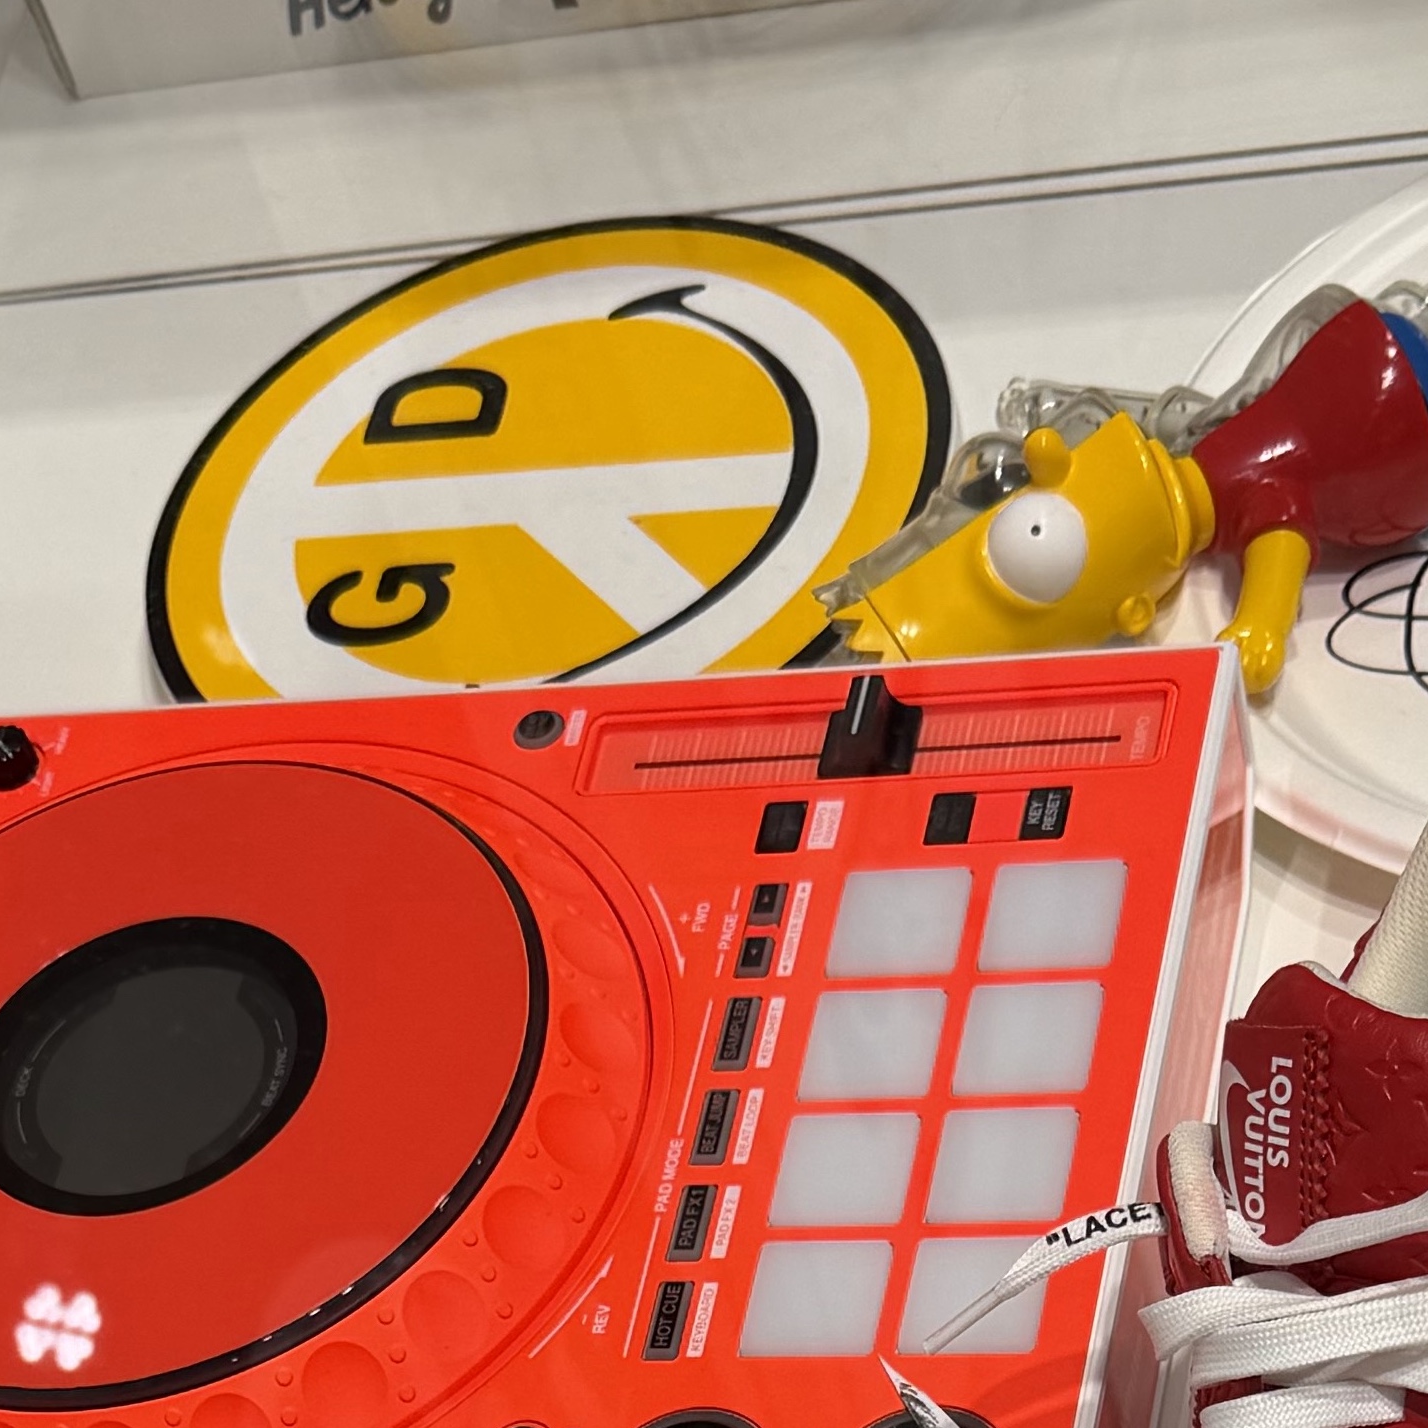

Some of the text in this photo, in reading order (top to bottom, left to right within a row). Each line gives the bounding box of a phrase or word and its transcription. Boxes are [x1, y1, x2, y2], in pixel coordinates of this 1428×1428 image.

[691, 902, 711, 933] FWD
[717, 913, 739, 950] PAGE
[1269, 1056, 1292, 1169] LOUIS
[653, 1138, 684, 1213] PAD MODE
[1046, 1202, 1163, 1249] "LACE
[653, 1284, 684, 1347] HOT CUE
[690, 1287, 715, 1353] KEYBOARD
